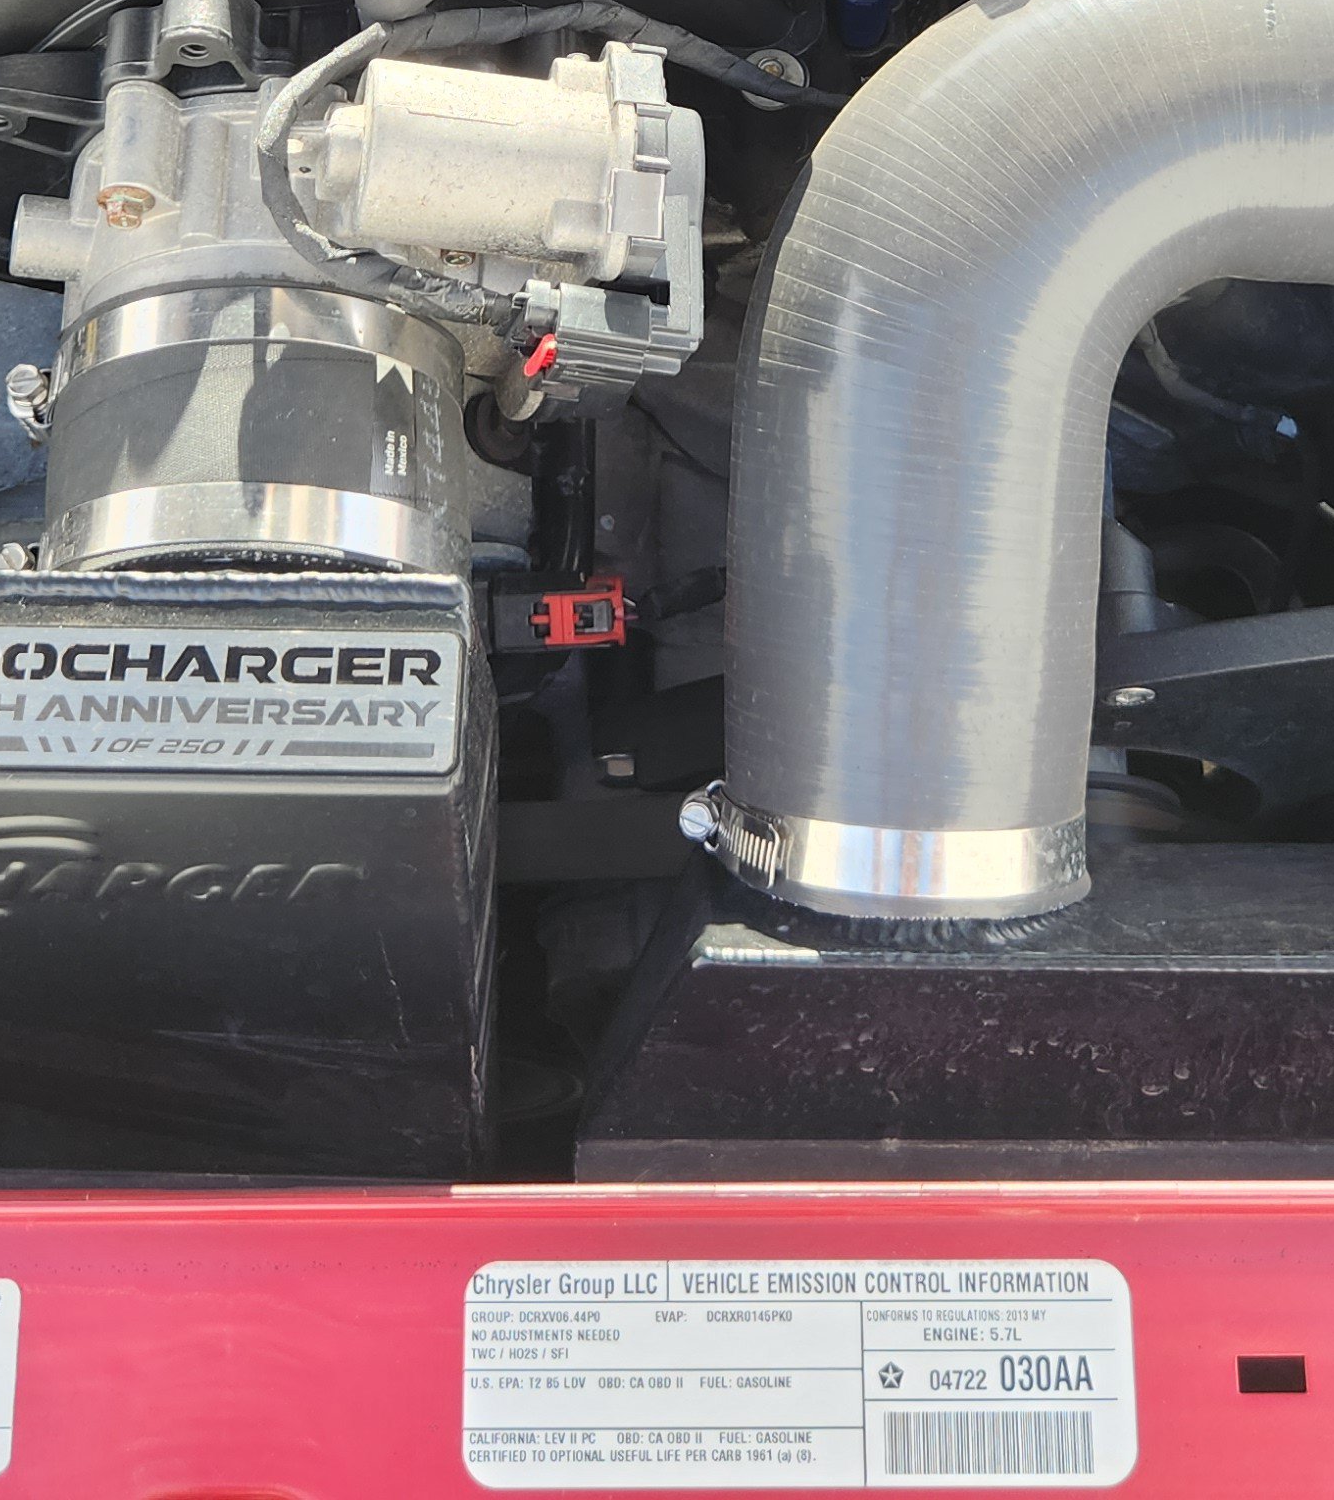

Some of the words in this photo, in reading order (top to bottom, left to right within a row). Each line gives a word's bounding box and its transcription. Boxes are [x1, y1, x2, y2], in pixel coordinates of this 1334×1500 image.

[384, 429, 396, 442] in
[384, 442, 395, 476] Made
[397, 434, 408, 477] Mexico
[35, 694, 443, 729] ANNIVERSARY
[89, 738, 105, 754] 1
[107, 739, 156, 754] OF
[158, 738, 224, 755] 250
[472, 1273, 552, 1300] Chrysler
[558, 1273, 615, 1299] Group
[623, 1272, 658, 1294] LLC
[682, 1272, 760, 1294] VEHICLE
[767, 1272, 856, 1294] EMISSION
[866, 1272, 951, 1294] CONTROL
[957, 1272, 1090, 1294] INFORMATION
[471, 1310, 515, 1323] GROUP:
[654, 1310, 688, 1323] EVAP:
[866, 1309, 918, 1321] CONFORMS
[921, 1309, 933, 1321] TO
[935, 1309, 1002, 1321] REGULATIONS:
[1005, 1309, 1029, 1321] 2013
[1031, 1309, 1047, 1321] MY
[471, 1329, 487, 1341] NO
[491, 1329, 573, 1341] ADJUSTMENTS
[576, 1329, 621, 1341] NEEDED
[923, 1327, 985, 1342] ENGINE:
[989, 1327, 1022, 1342] 5.7L
[471, 1347, 496, 1360] TWC
[550, 1347, 569, 1360] SFI
[929, 1368, 988, 1391] 04722
[999, 1354, 1094, 1392] 030AA
[471, 1376, 494, 1389] U.S.
[498, 1376, 524, 1389] EPA:
[529, 1376, 543, 1389] T2
[564, 1376, 586, 1389] LDV
[598, 1376, 625, 1389] OBD:
[629, 1376, 645, 1389] CA
[648, 1376, 672, 1389] OBD
[675, 1376, 684, 1389] II
[699, 1376, 732, 1389] FUEL:
[736, 1376, 792, 1389] GASOLINE
[469, 1432, 540, 1445] CALIFORNIA:
[544, 1432, 566, 1445] LEV
[569, 1432, 577, 1445] II
[581, 1432, 596, 1445] PC
[617, 1432, 644, 1445] OBD:
[648, 1432, 663, 1445] CA
[667, 1432, 691, 1445] OBD
[694, 1432, 703, 1445] II
[718, 1431, 752, 1444] FUEL:
[756, 1431, 812, 1444] GASOLINE
[468, 1450, 527, 1463] CERTIFIED
[531, 1450, 546, 1463] TO
[549, 1450, 605, 1463] OPTIONAL
[610, 1450, 653, 1463] USEFUL
[656, 1450, 681, 1463] LIFE
[685, 1450, 707, 1463] PER
[711, 1450, 742, 1463] CARB
[745, 1449, 773, 1462] 1961
[777, 1449, 792, 1463] (a)
